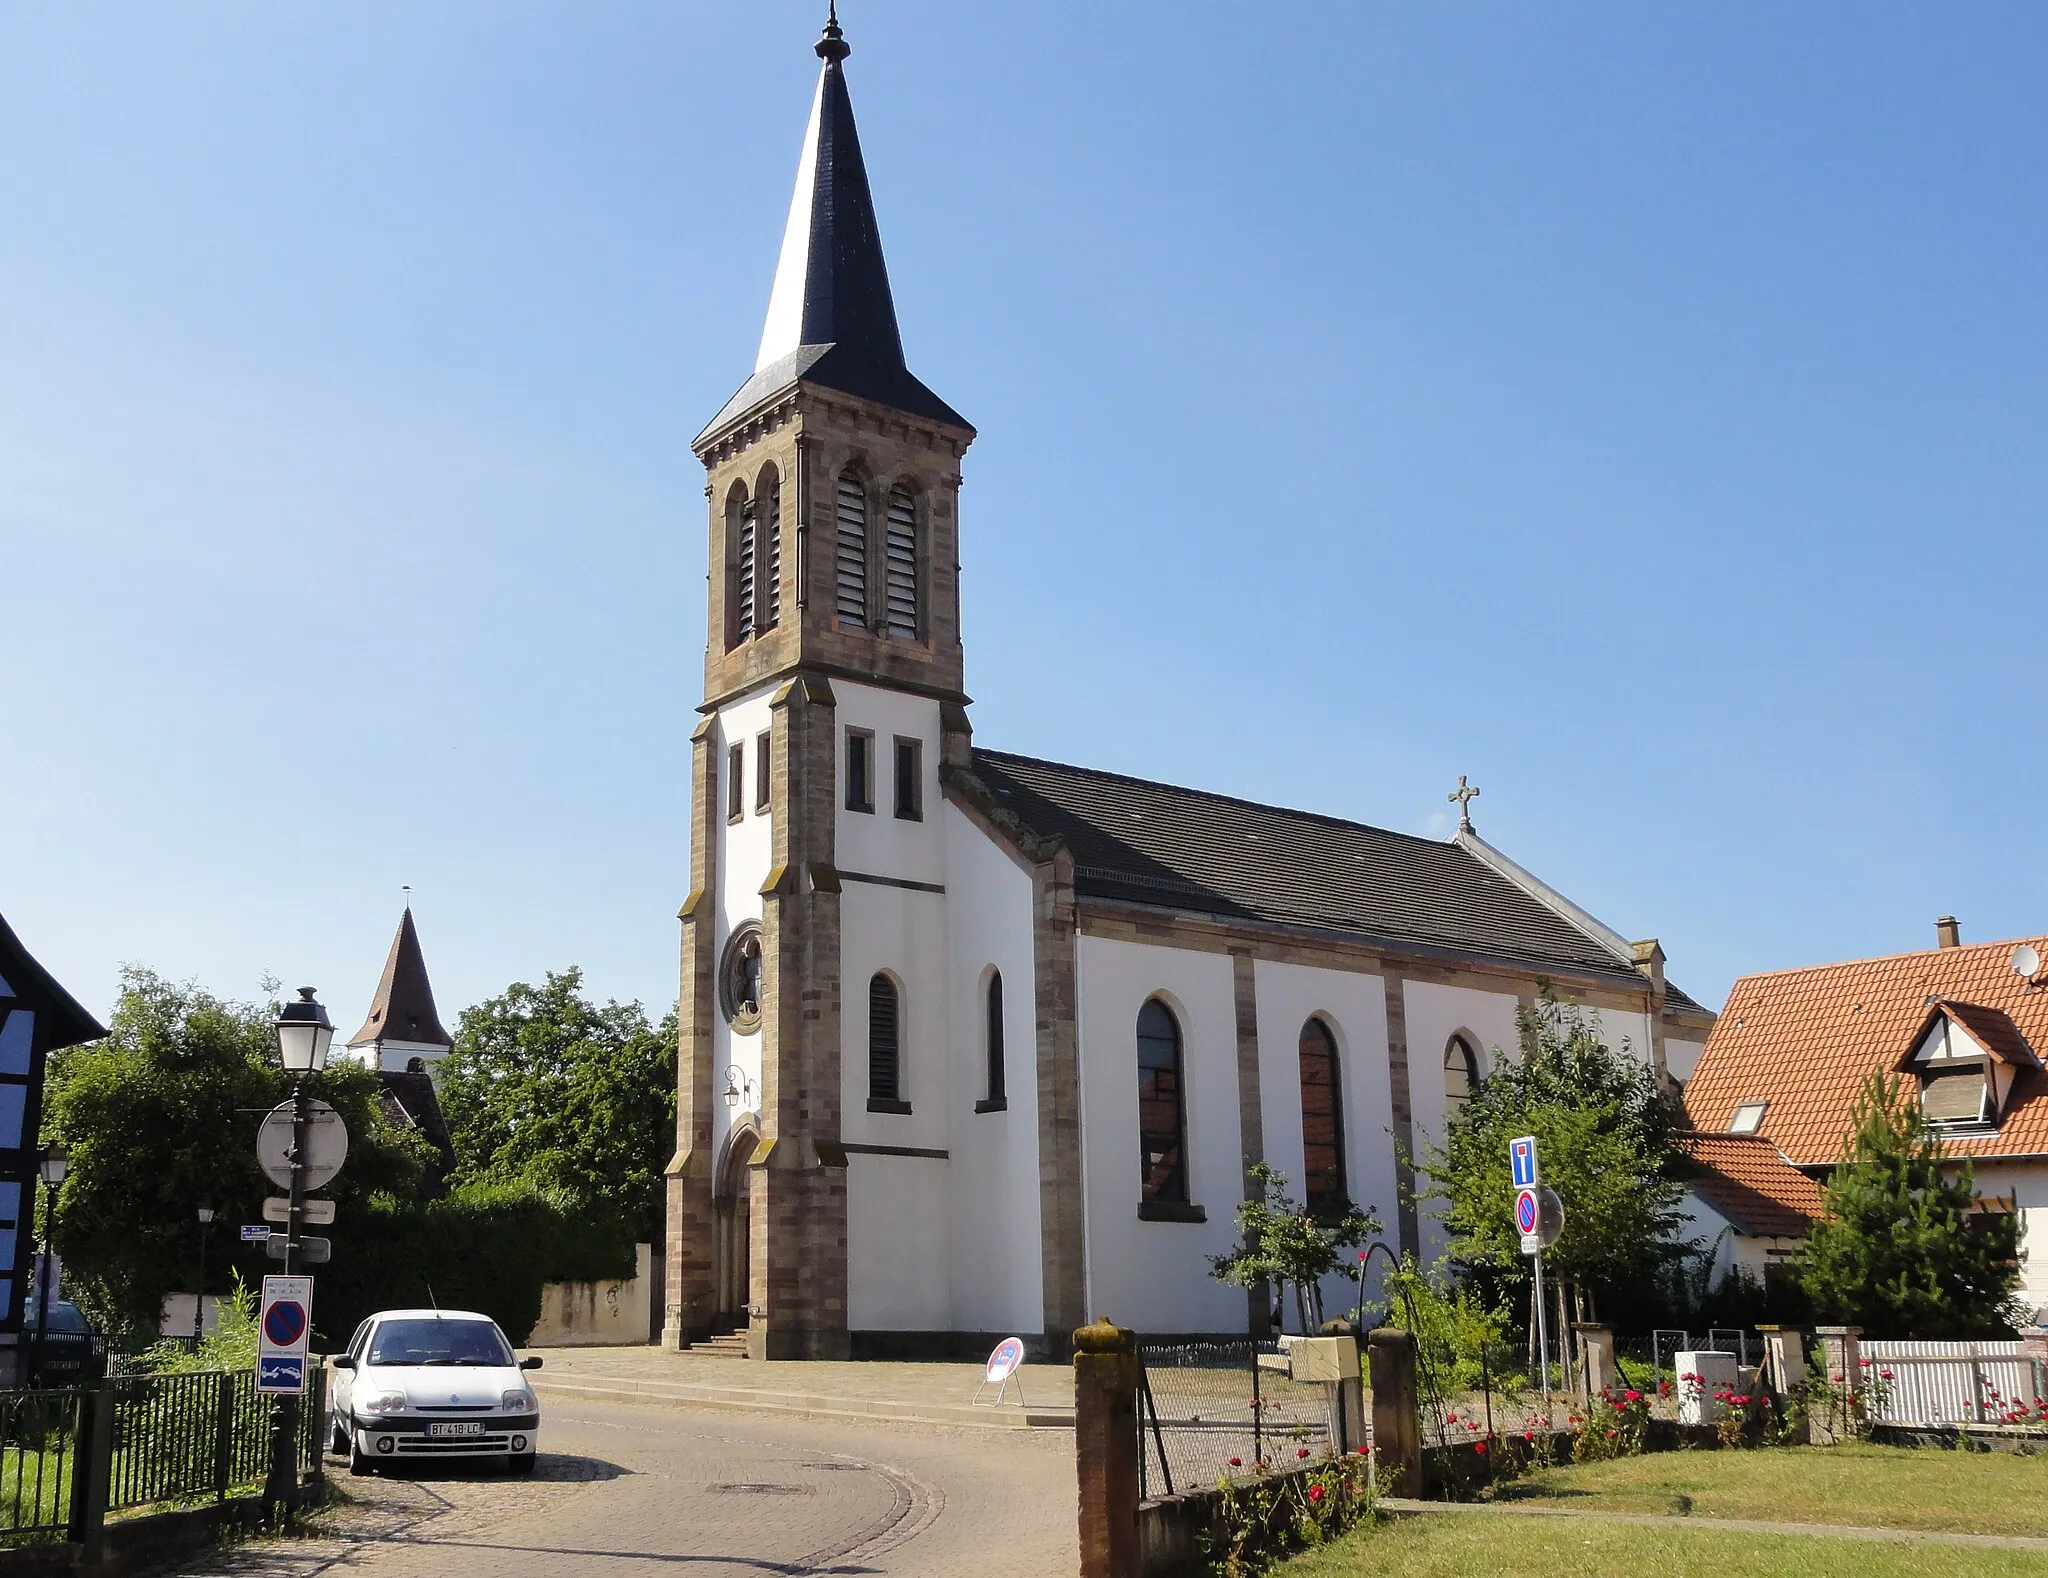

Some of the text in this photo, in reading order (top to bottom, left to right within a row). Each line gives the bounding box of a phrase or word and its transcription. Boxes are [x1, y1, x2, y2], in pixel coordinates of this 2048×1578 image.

[432, 1424, 479, 1435] BT 418 LC
